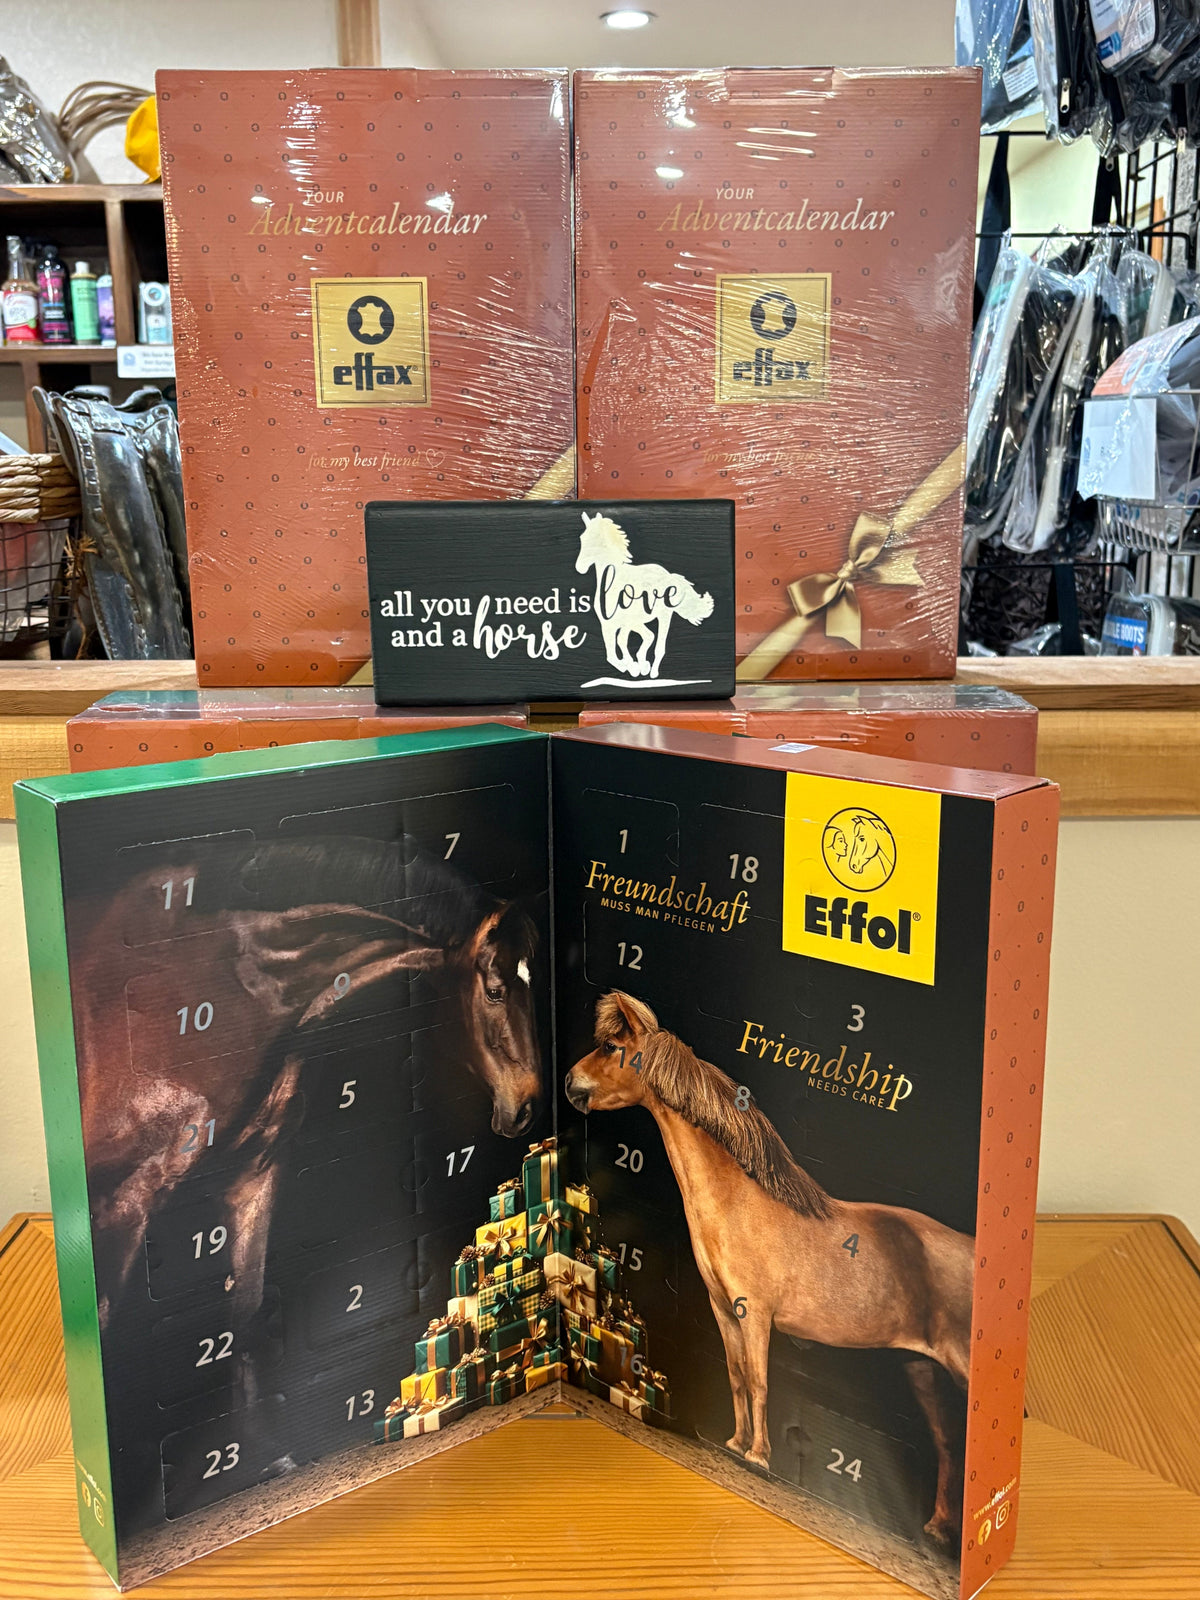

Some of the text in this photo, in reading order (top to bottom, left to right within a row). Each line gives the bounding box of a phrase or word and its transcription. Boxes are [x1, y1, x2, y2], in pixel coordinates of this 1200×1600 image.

[715, 188, 755, 200] YOUR
[248, 202, 488, 236] Adventcalendar
[656, 198, 896, 232] Adventcalendar
[330, 456, 351, 471] my
[353, 452, 378, 467] best
[378, 452, 420, 471] friend
[380, 564, 687, 623] all you need is love
[391, 595, 588, 660] and a horse
[444, 832, 461, 860] 7
[619, 829, 629, 854] 1
[728, 853, 760, 884] 18
[161, 876, 196, 911] 11
[584, 859, 752, 933] Freundschaft
[601, 897, 715, 934] MUSS MAN PFLEGEN
[617, 942, 644, 971] 12
[333, 972, 351, 1001] 9
[176, 1001, 215, 1035] 10
[847, 1004, 866, 1032] 3
[617, 1046, 643, 1075] 14
[736, 1020, 914, 1112] Friendship
[339, 1080, 357, 1109] 5
[734, 1085, 751, 1112] 8
[807, 1076, 885, 1109] NEEDS CARE
[180, 1118, 216, 1154] 21
[445, 1145, 476, 1177] 17
[614, 1143, 644, 1173] 20
[191, 1225, 228, 1259] 19
[617, 1242, 644, 1271] 15
[841, 1233, 859, 1258] 4
[346, 1284, 364, 1312] 2
[732, 1296, 748, 1319] 6
[195, 1331, 234, 1368] 22
[618, 1346, 643, 1375] 16
[345, 1389, 375, 1421] 13
[202, 1442, 240, 1480] 23
[826, 1448, 863, 1482] 24
